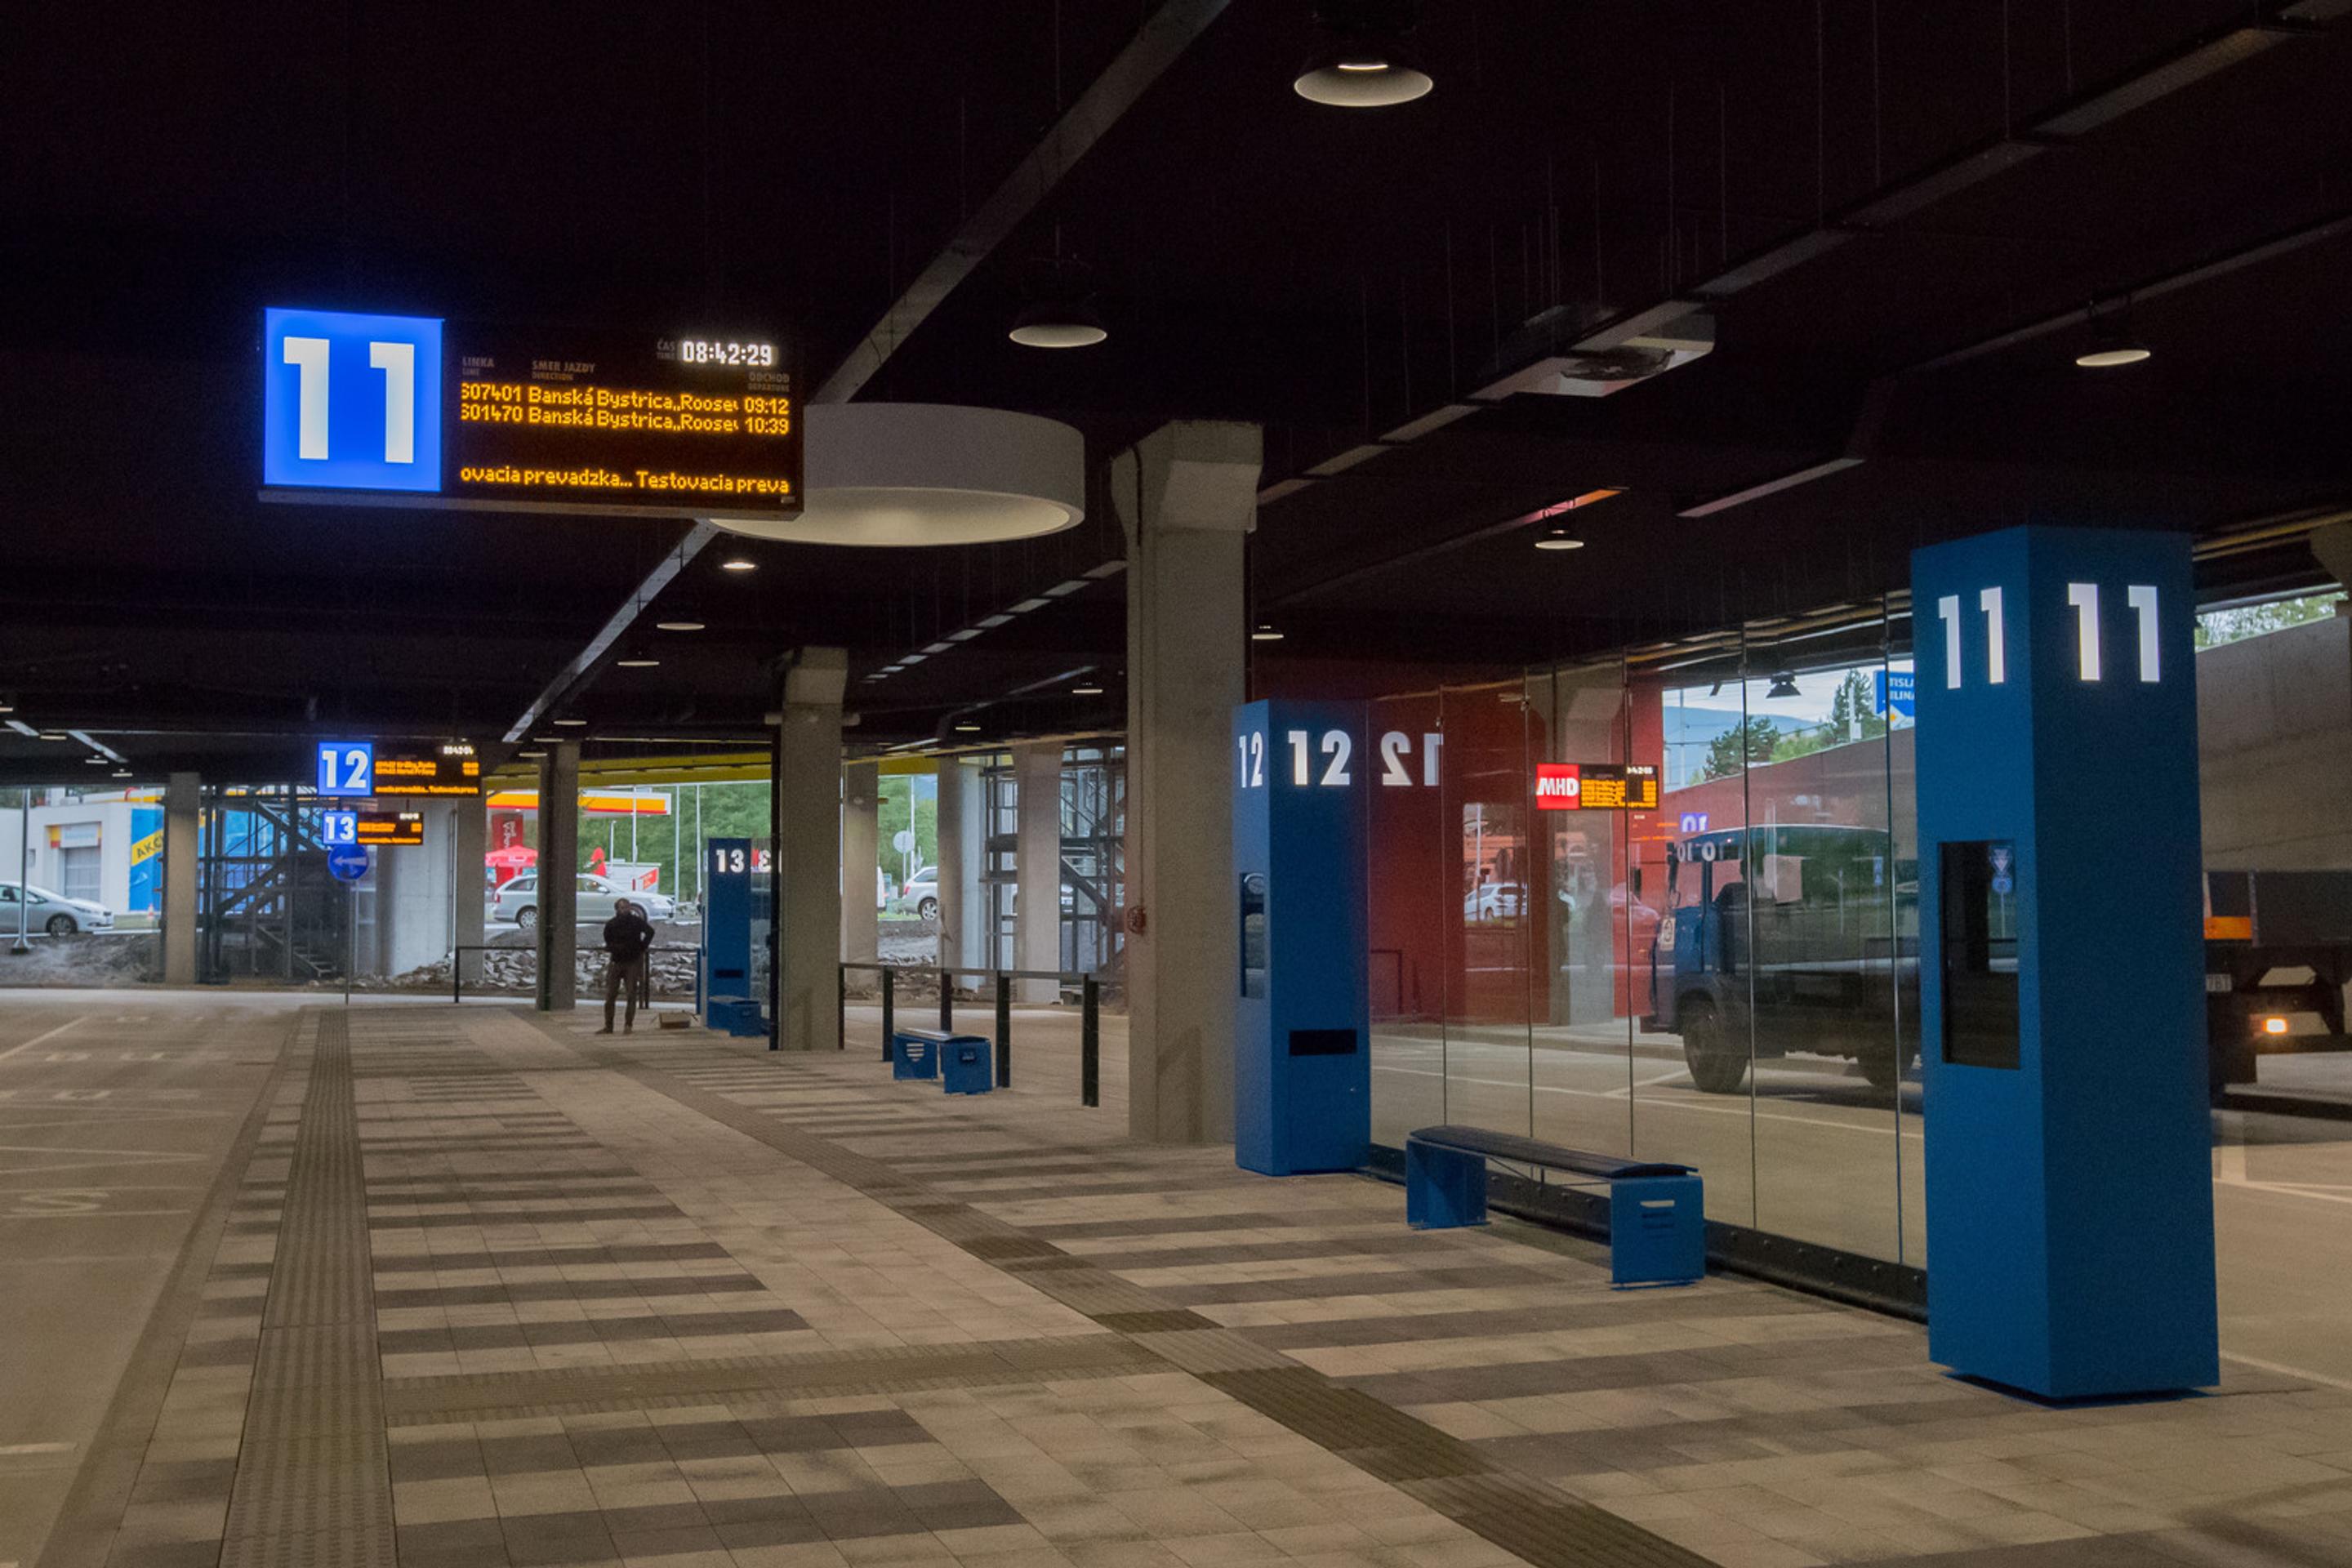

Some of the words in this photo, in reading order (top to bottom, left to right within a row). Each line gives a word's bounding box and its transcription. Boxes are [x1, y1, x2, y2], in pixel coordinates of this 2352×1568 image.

[532, 360, 562, 371] SMER
[564, 362, 595, 373] JAZDY
[682, 341, 772, 366] 08:42:29
[283, 336, 415, 464] 11
[528, 385, 594, 407] Banská
[744, 395, 790, 415] 09:12
[528, 406, 594, 426] Banská
[744, 416, 790, 435] 10:39
[461, 466, 520, 483] ovacia
[523, 469, 633, 488] prevadzka...
[635, 470, 733, 491] Testovacia
[737, 478, 790, 493] preva
[1939, 586, 2004, 689] 11
[2068, 582, 2160, 682] 11
[322, 750, 369, 788] 12
[1239, 731, 1263, 788] 12
[1288, 729, 1352, 786] 12
[1536, 777, 1579, 796] MHD
[325, 816, 354, 840] 13
[716, 849, 745, 873] 13
